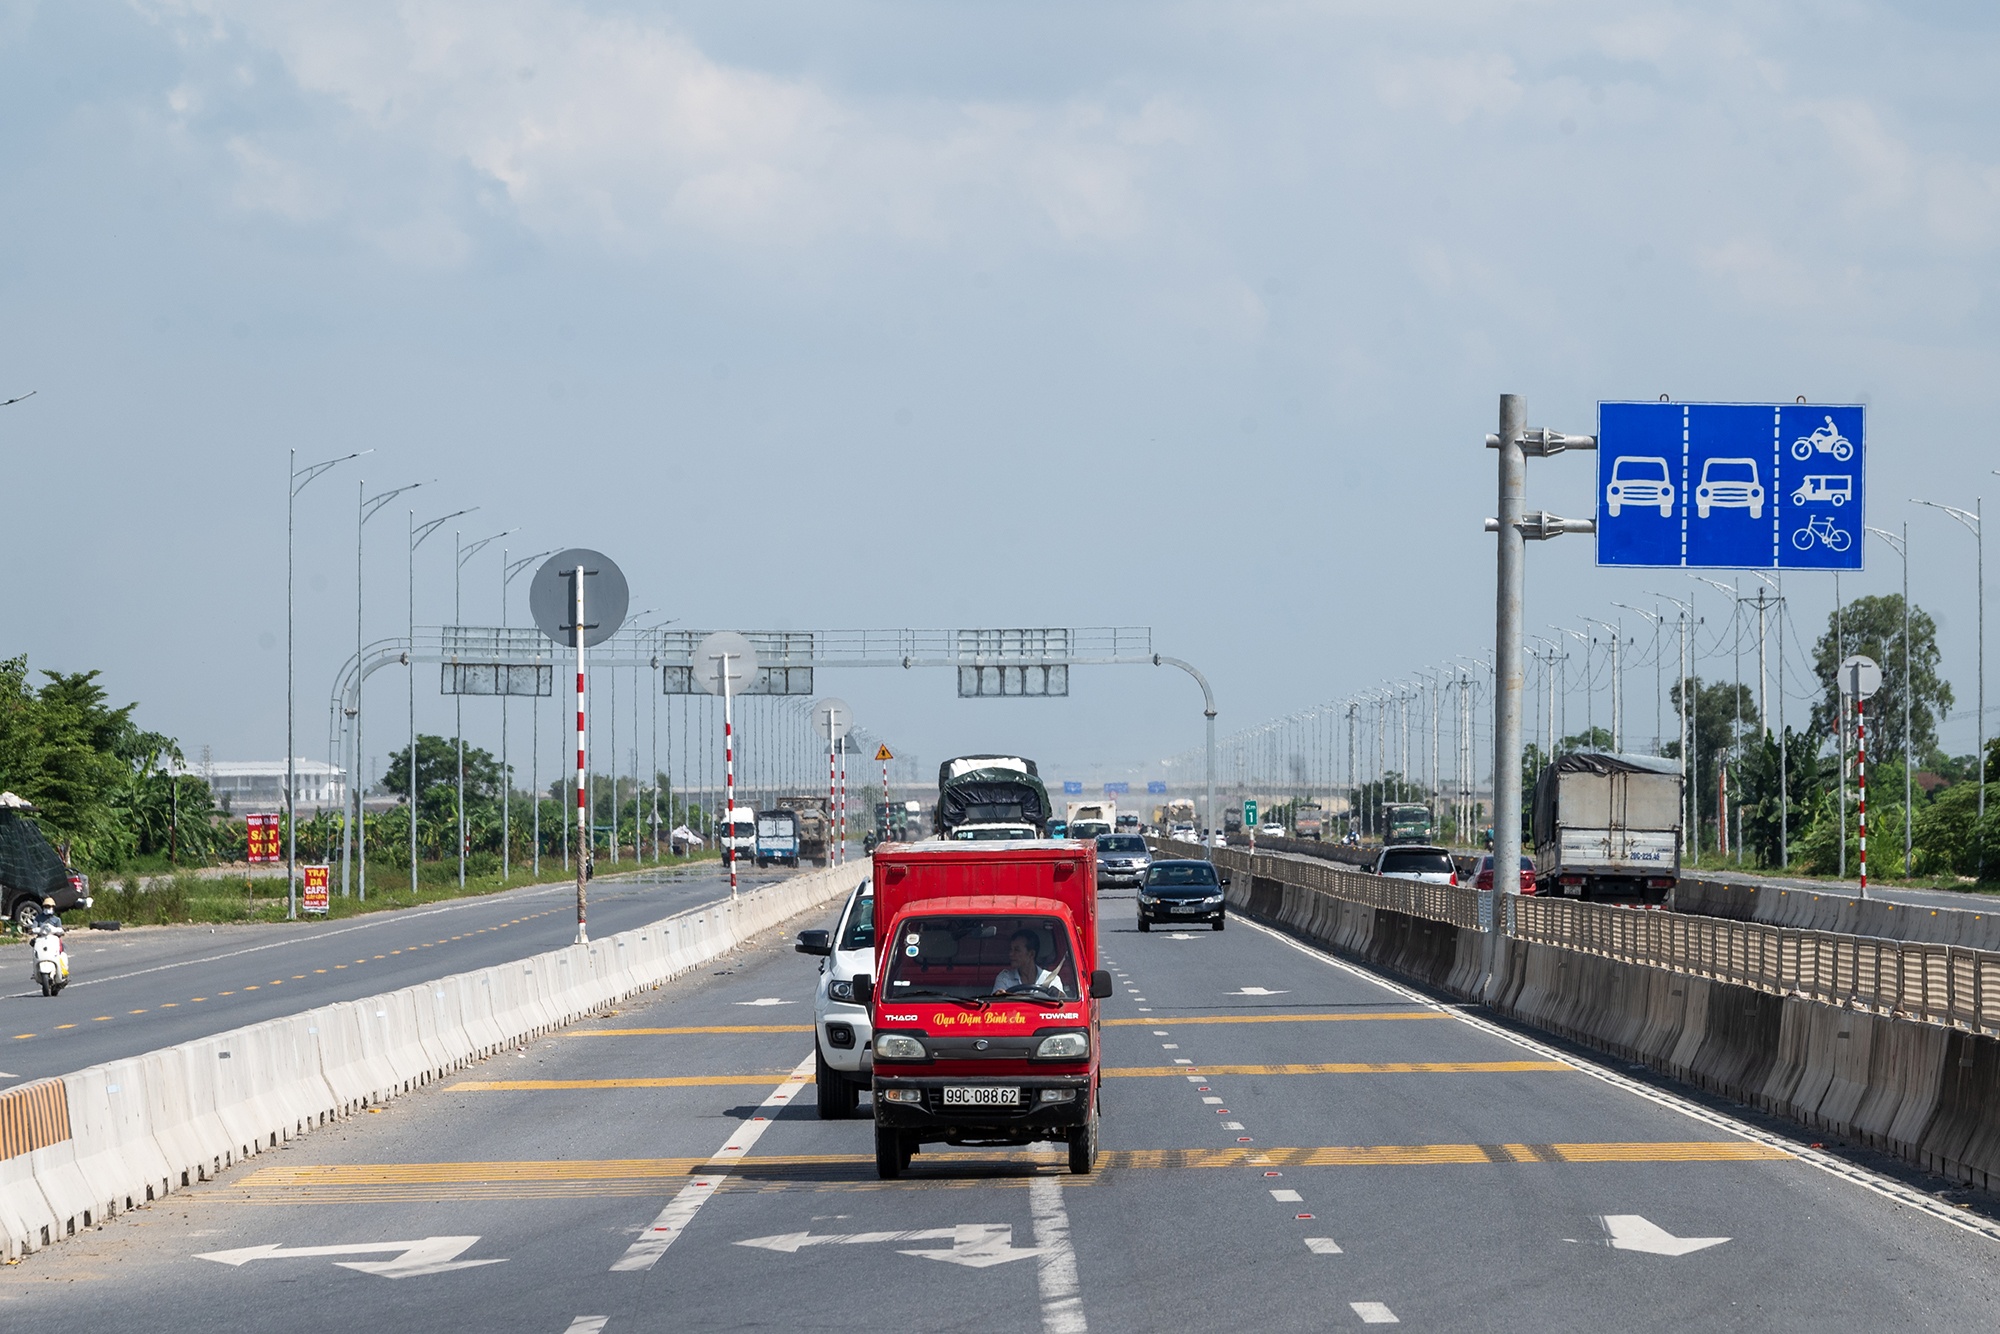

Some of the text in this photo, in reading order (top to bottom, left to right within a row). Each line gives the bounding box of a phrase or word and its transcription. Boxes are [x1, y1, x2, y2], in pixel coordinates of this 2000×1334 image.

[1248, 811, 1253, 823] 1
[249, 842, 277, 855] VỤN
[885, 1014, 918, 1022] THACO
[933, 1011, 1026, 1027] Vạn Dặm Bình An
